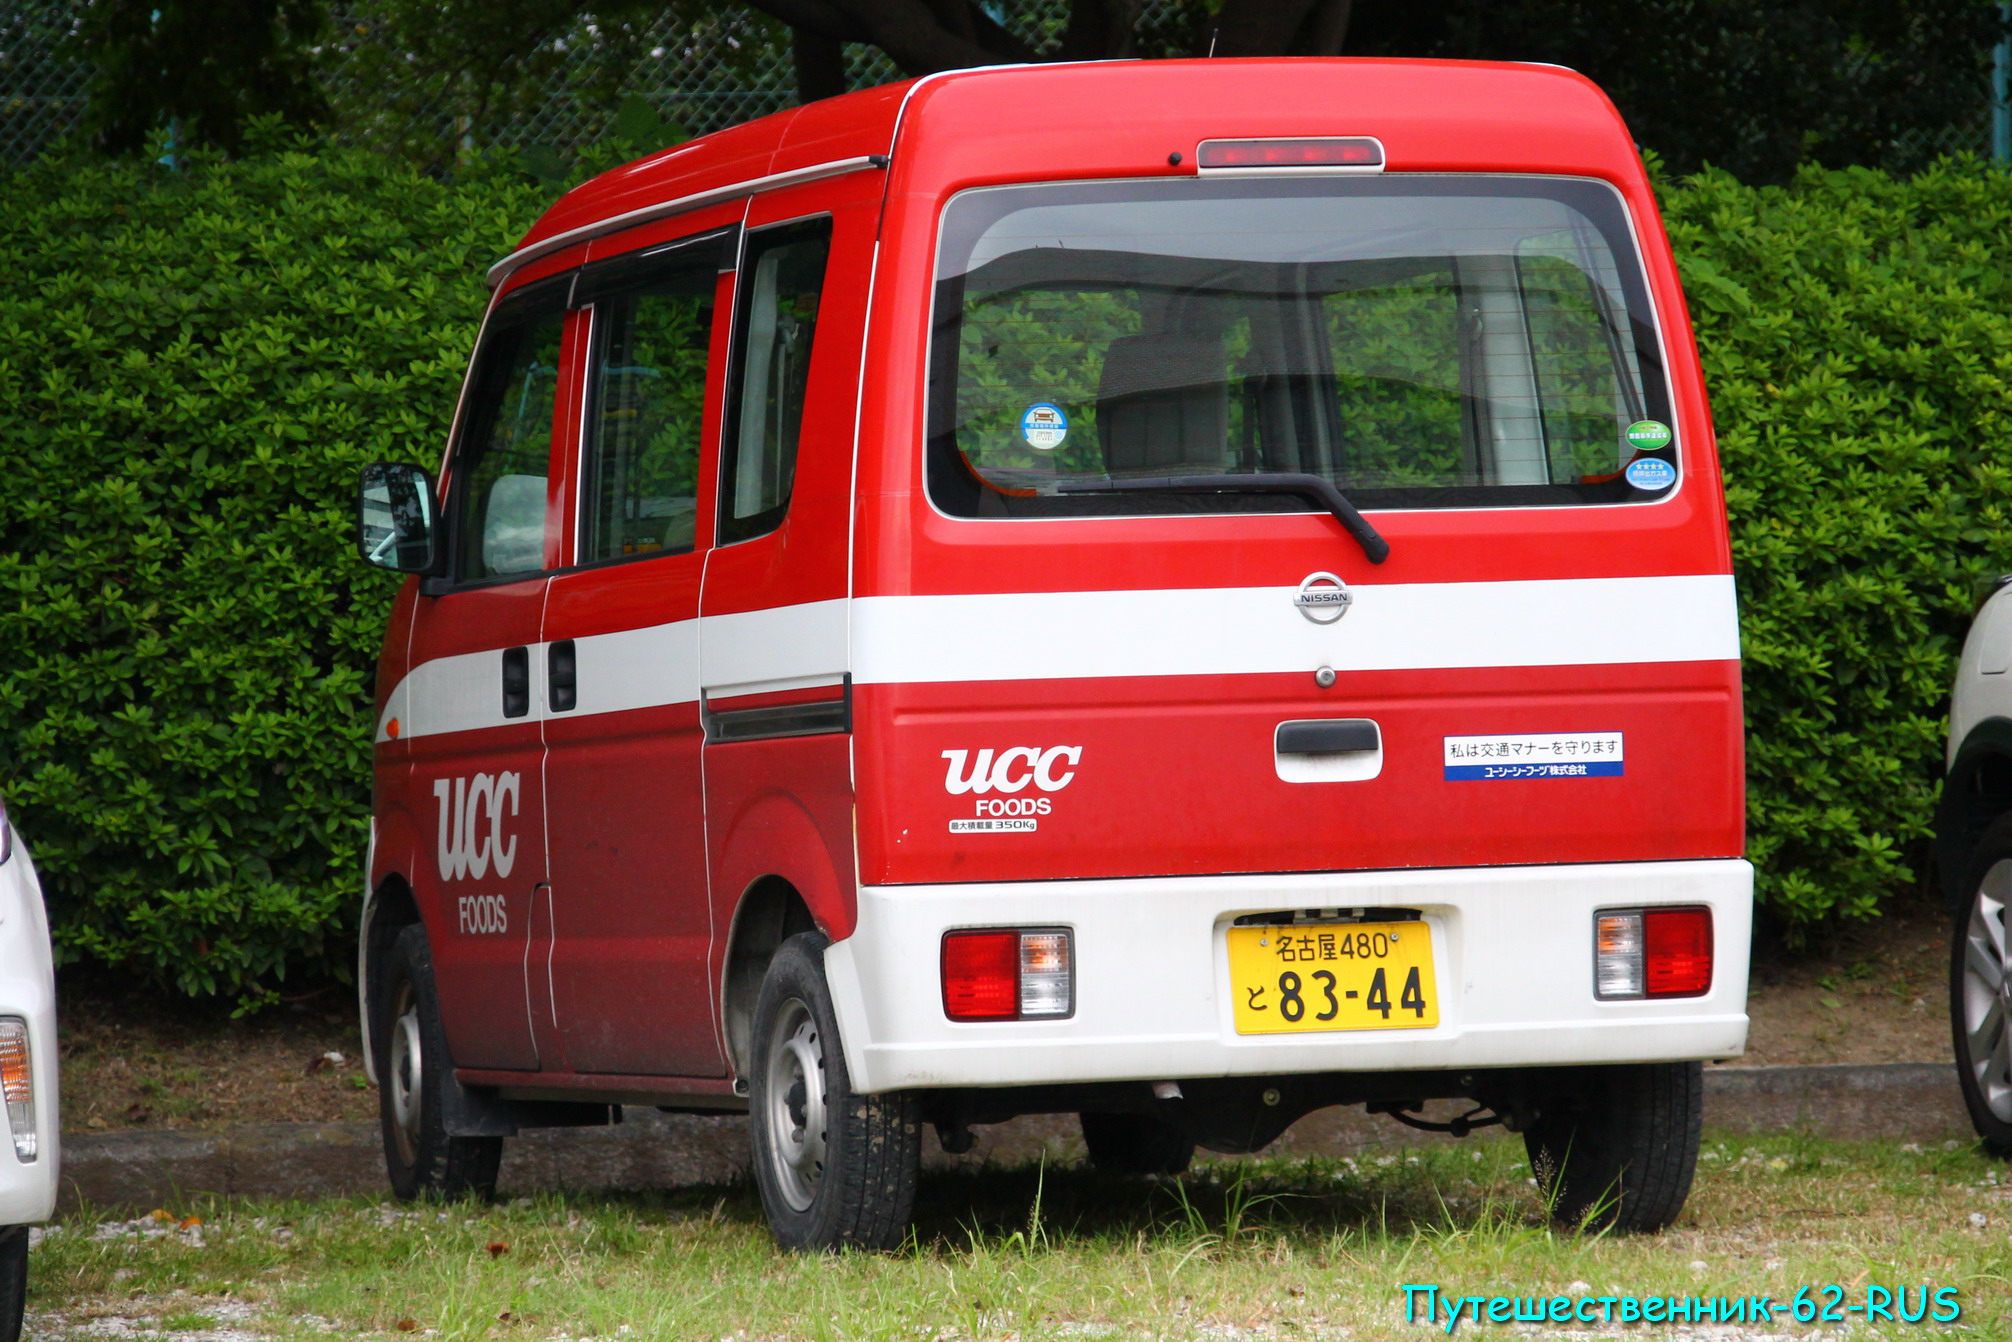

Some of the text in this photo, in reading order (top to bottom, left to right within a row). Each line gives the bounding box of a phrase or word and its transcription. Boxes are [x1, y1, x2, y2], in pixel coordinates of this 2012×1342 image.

[1301, 593, 1348, 602] NISSAN
[1450, 739, 1618, 758] 私は交通マナーを守ります
[976, 797, 1052, 817] FOODS
[950, 821, 993, 830] 最大積載量
[458, 893, 508, 935] FOODS
[1246, 966, 1426, 1023] と 83-44
